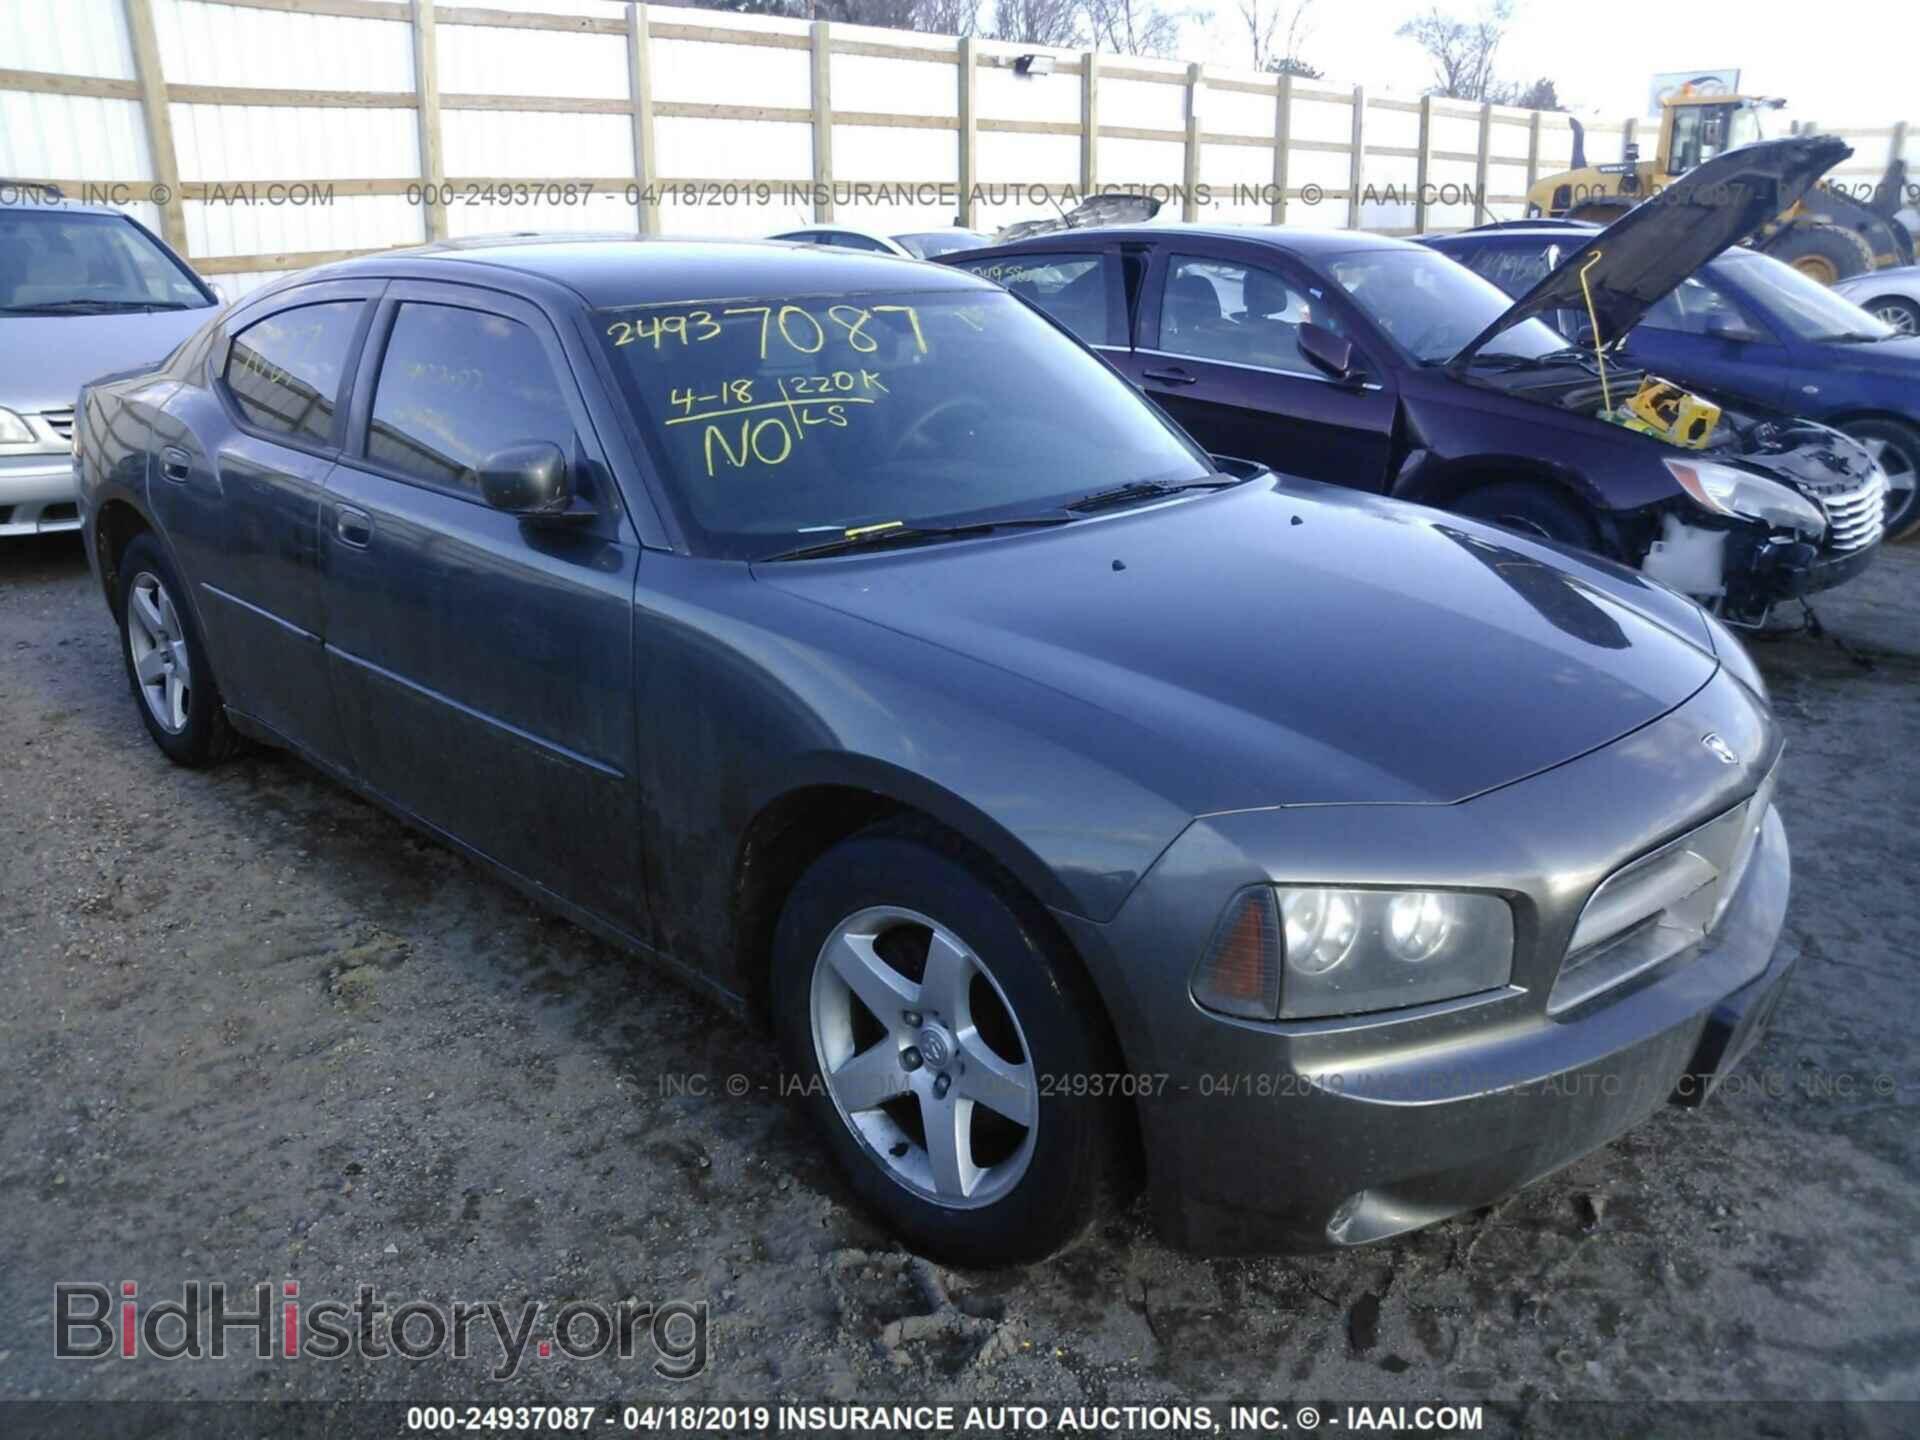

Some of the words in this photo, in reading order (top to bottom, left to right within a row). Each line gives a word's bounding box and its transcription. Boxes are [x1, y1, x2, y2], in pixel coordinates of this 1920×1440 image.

[606, 305, 928, 359] 24937087
[671, 379, 754, 413] 4-18
[704, 418, 792, 477] NO
